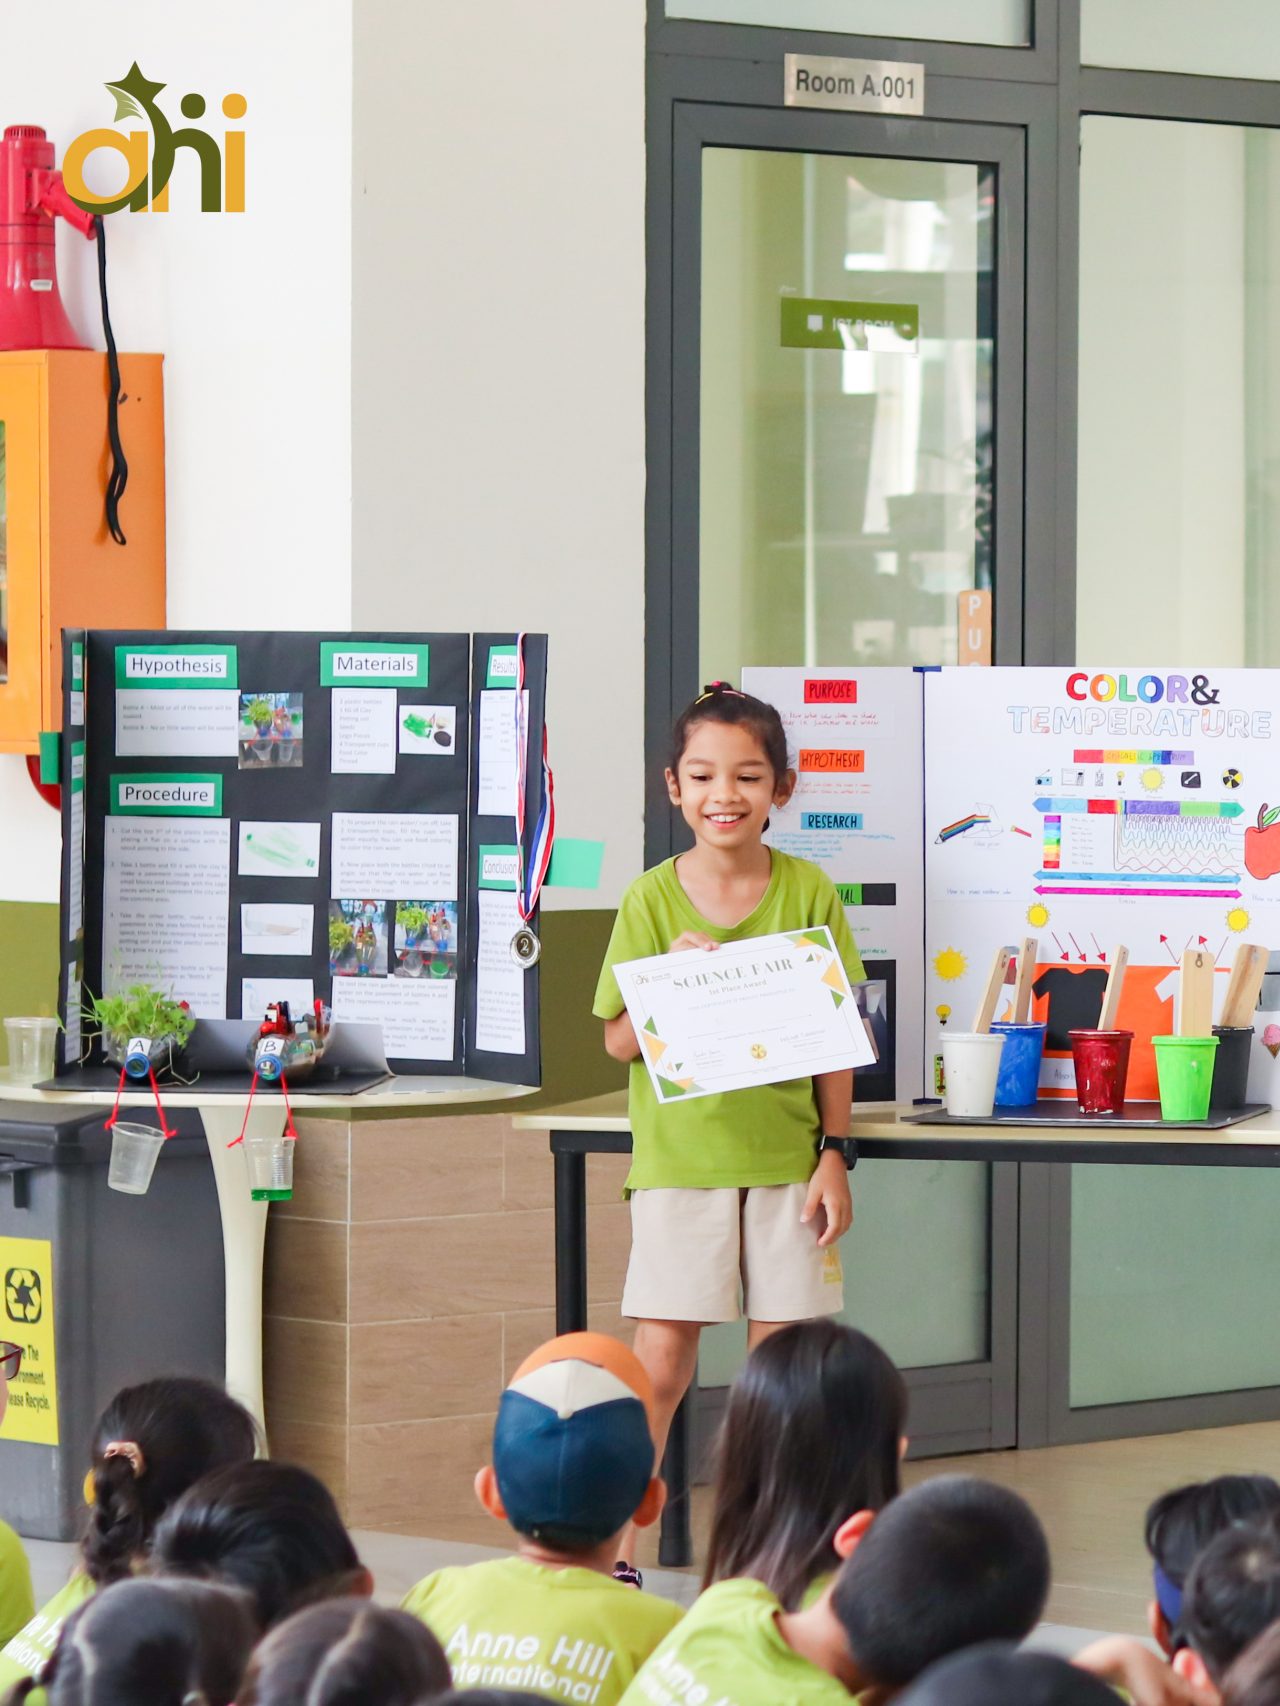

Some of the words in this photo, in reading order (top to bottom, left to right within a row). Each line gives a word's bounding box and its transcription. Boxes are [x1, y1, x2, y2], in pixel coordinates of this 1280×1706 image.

[796, 69, 855, 95] Room
[862, 74, 914, 99] A.001
[132, 657, 222, 674] Hypothesis
[337, 656, 414, 671] Materials
[492, 658, 516, 674] Results
[809, 682, 852, 699] PURPOSE
[1007, 705, 1272, 739] TEMPERATURE
[802, 752, 860, 768] HYPOTHESIS
[125, 786, 209, 802] Procedure
[808, 814, 857, 829] RESEARCH
[484, 859, 517, 874] Conclusion
[520, 937, 529, 953] 2
[673, 966, 744, 990] SCIENCE
[752, 958, 793, 976] FAIR
[135, 1040, 144, 1052] A
[263, 1040, 276, 1052] B
[27, 1344, 39, 1361] The
[25, 1391, 50, 1413] Recycle.
[444, 1622, 541, 1662] Anne
[550, 1634, 616, 1682] Hill
[450, 1659, 602, 1705] nternational
